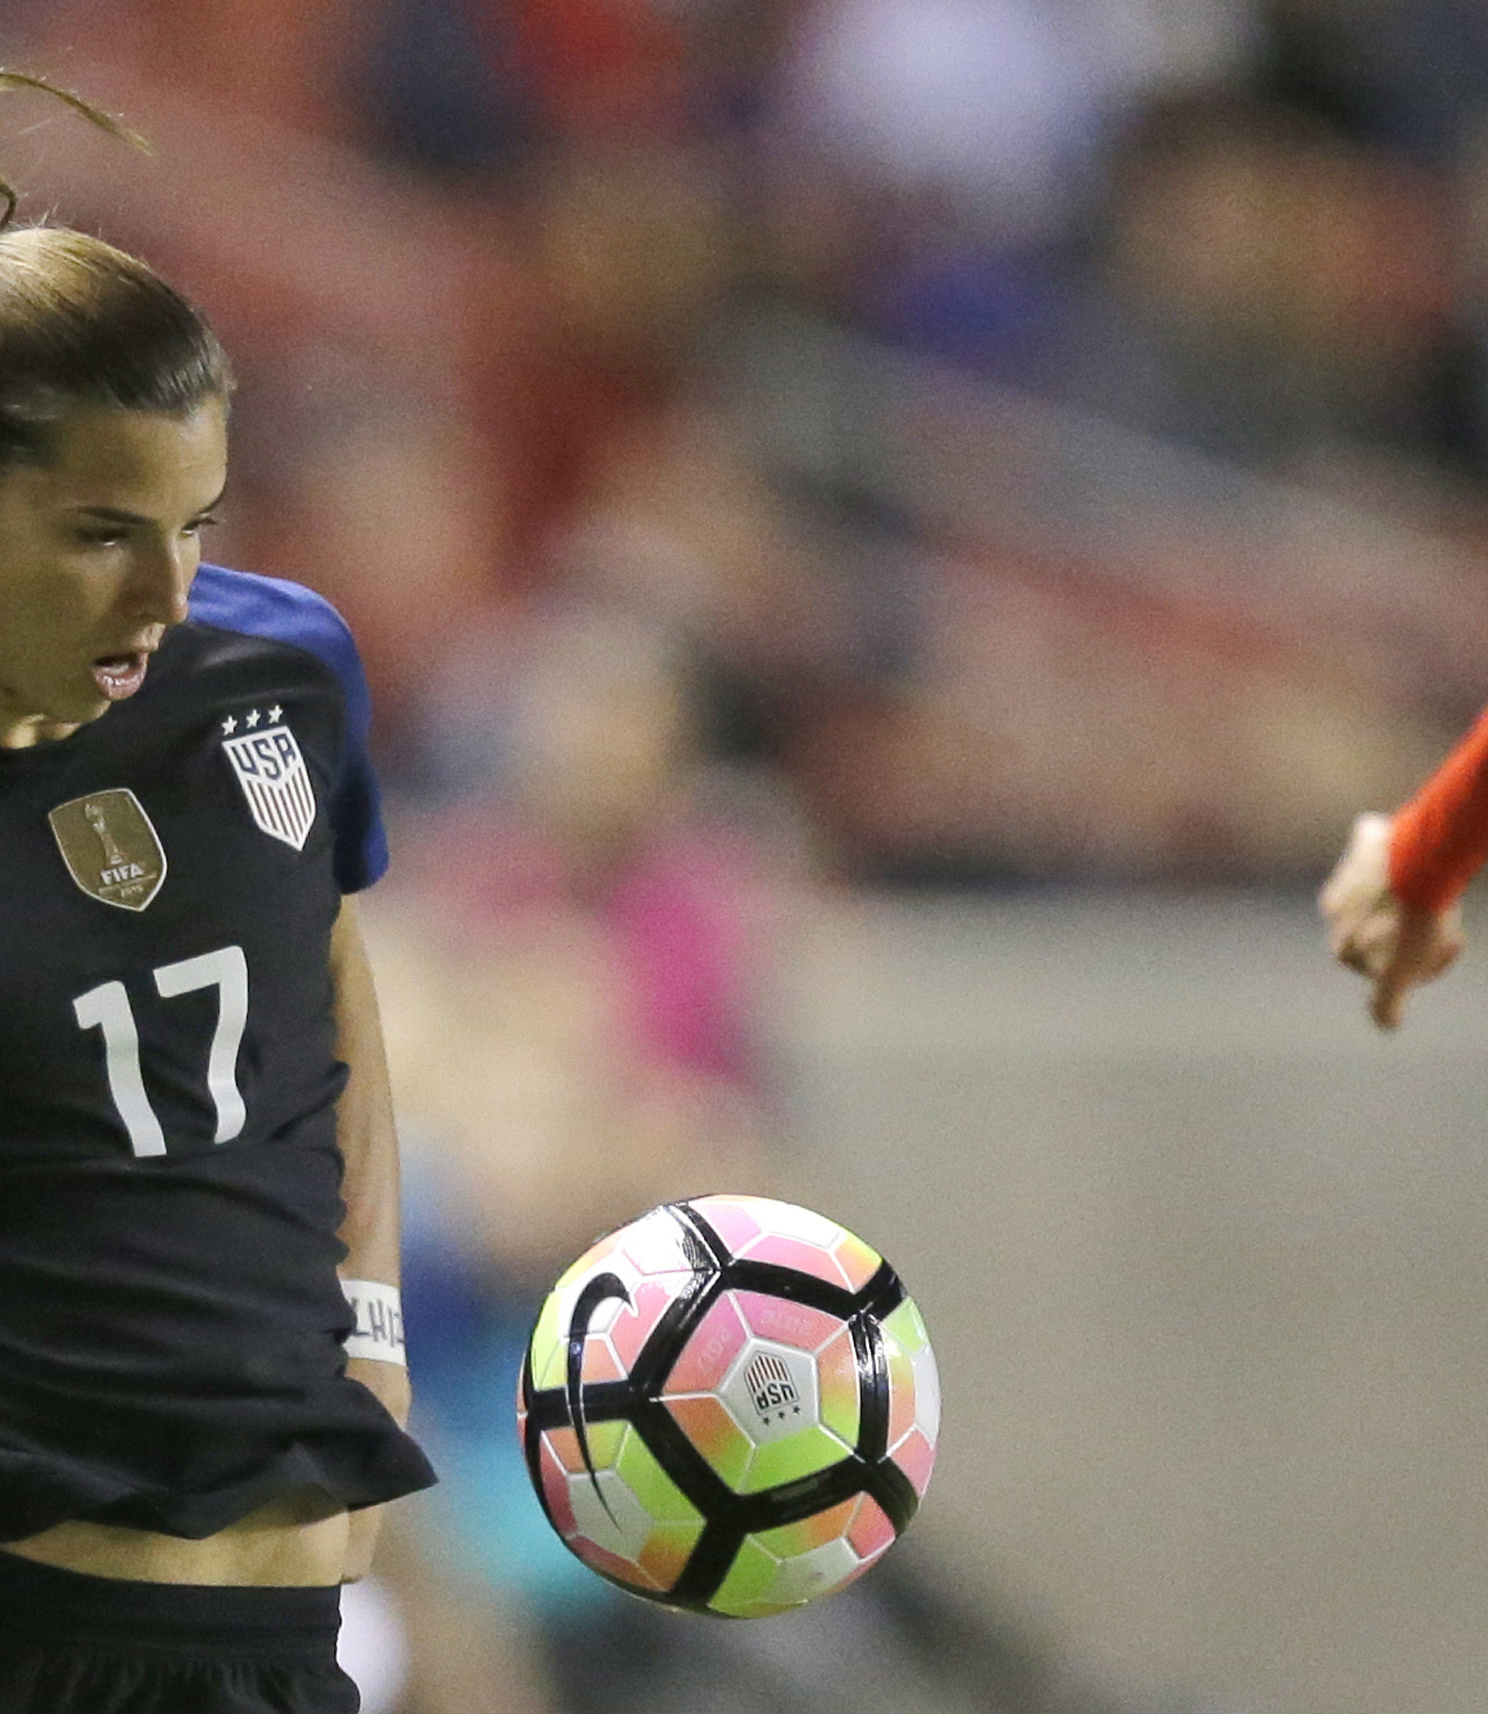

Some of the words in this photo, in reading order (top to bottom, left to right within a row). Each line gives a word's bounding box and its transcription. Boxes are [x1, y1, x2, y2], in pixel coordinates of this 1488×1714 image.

[230, 733, 297, 781] USA
[100, 862, 145, 885] FIFA
[72, 945, 249, 1158] 17
[755, 1382, 795, 1411] USA
